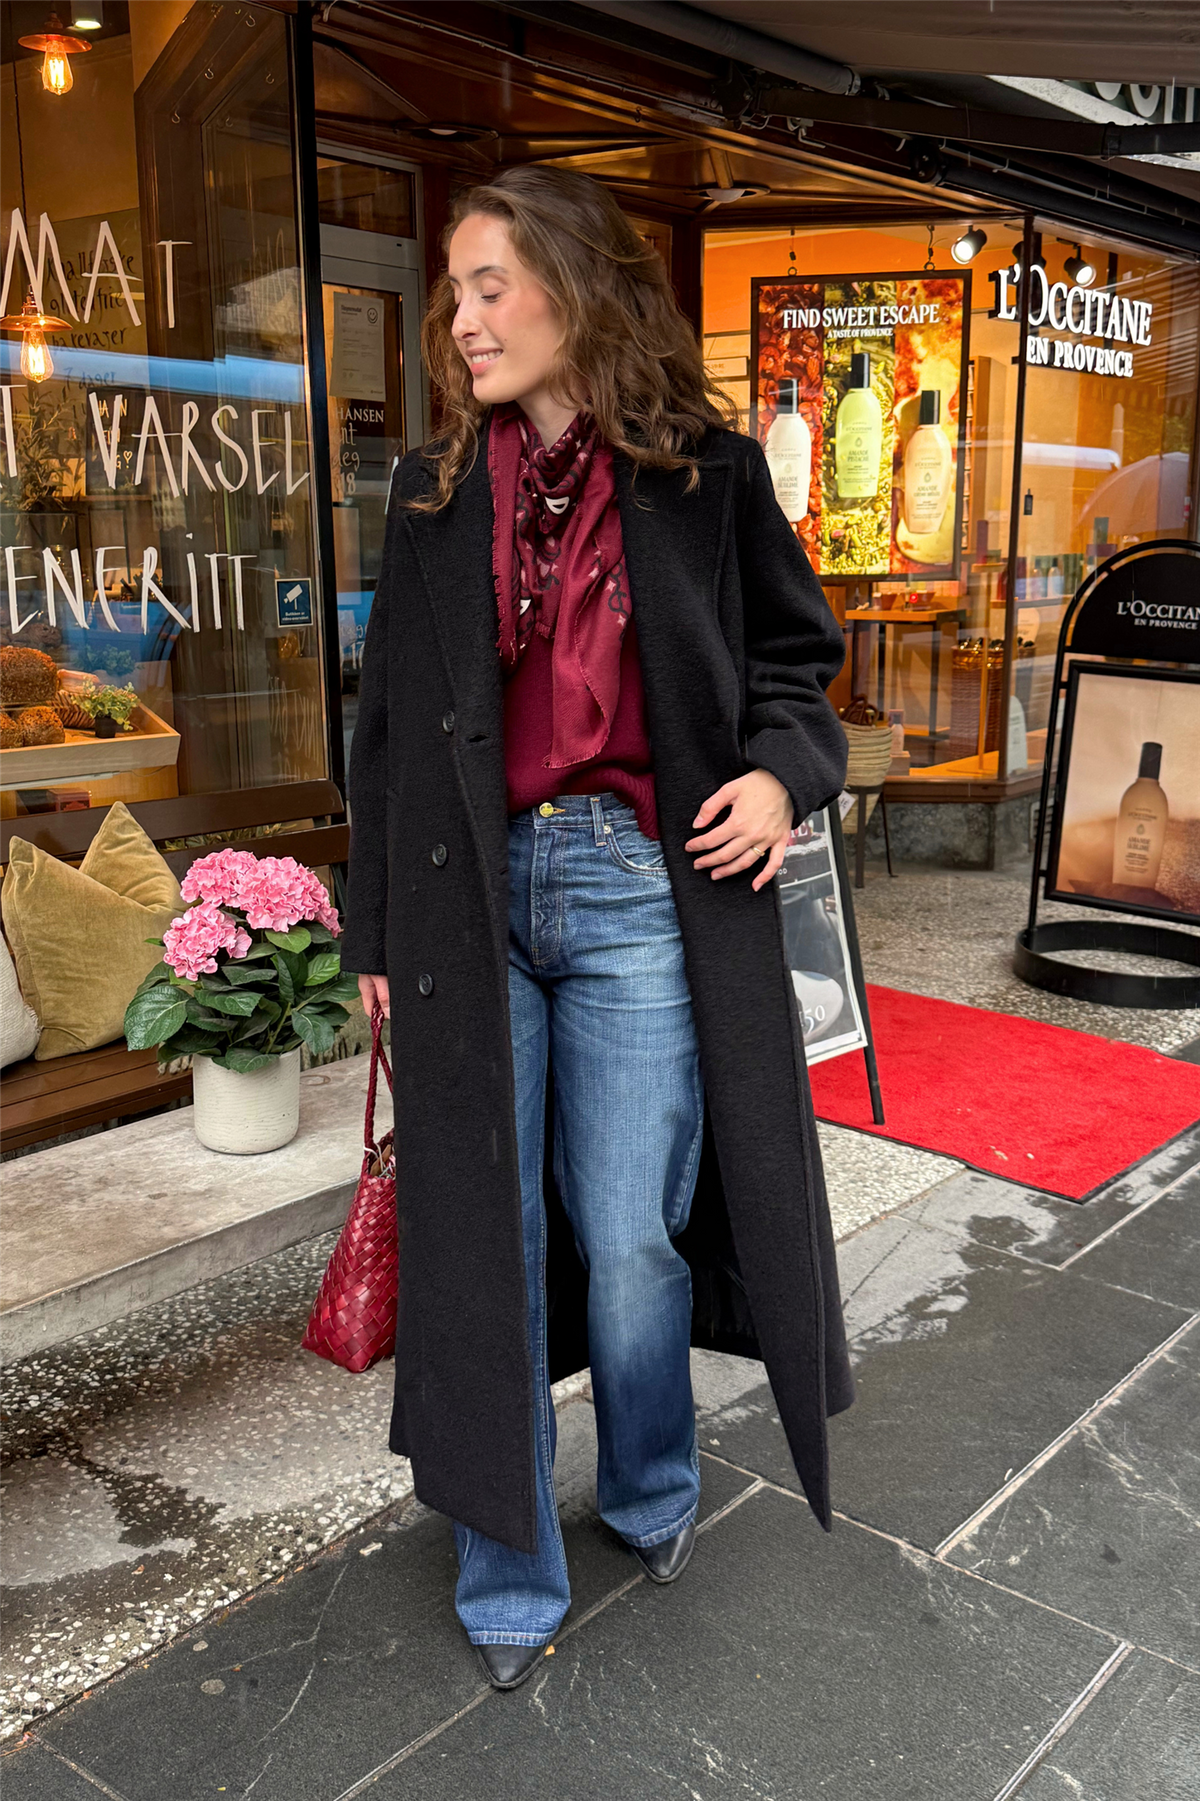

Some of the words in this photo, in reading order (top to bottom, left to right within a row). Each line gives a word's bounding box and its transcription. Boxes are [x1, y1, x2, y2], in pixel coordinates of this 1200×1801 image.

[0, 207, 193, 329] MAT
[783, 308, 821, 329] FIND
[822, 305, 878, 328] SWEET
[880, 303, 941, 325] ESCAPE
[998, 263, 1152, 346] L'OCCITANE
[827, 330, 833, 338] A
[833, 329, 851, 338] TASTE
[851, 329, 860, 338] OF
[860, 327, 894, 338] PROVENCE
[1026, 335, 1049, 365] EN
[1054, 340, 1133, 378] PROVENCE
[335, 407, 385, 423] HANSEN
[88, 392, 310, 498] VARSEL
[1134, 618, 1147, 626] EN
[1149, 619, 1198, 630] PROVENCE
